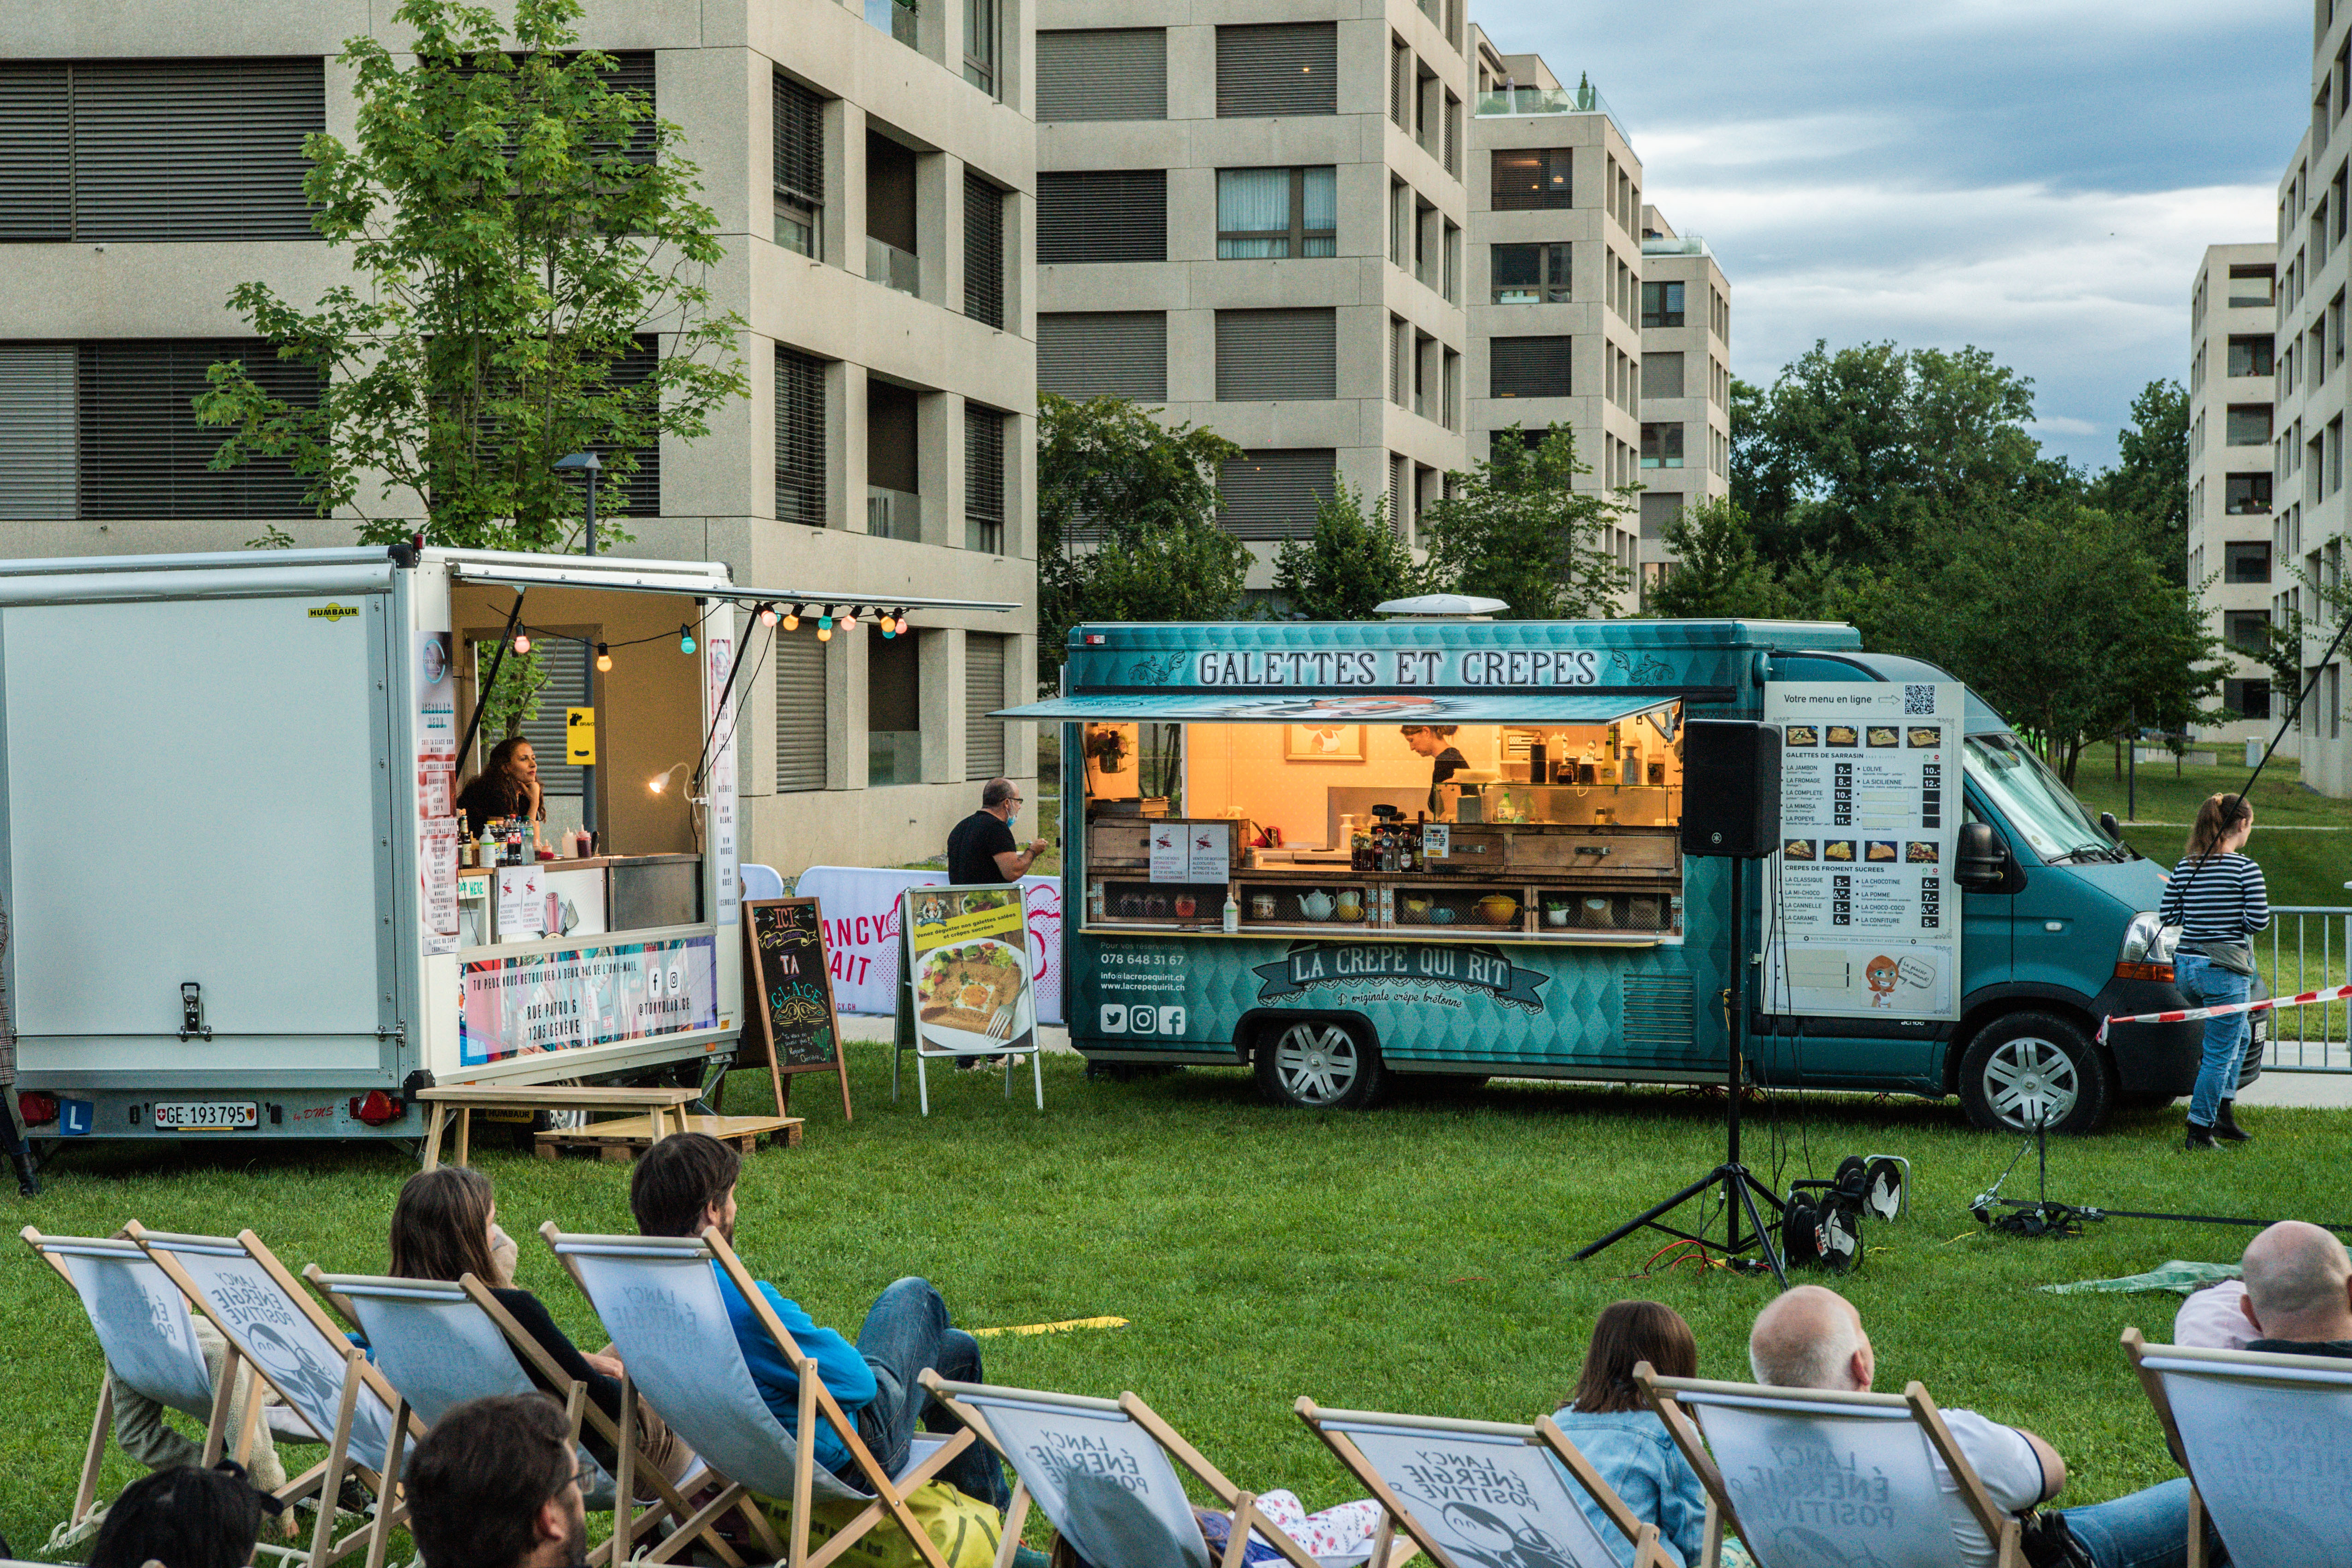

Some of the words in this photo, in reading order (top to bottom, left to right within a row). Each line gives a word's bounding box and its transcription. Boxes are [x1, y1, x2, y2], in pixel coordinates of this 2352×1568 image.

[1200, 652, 1376, 685] GALETTES
[1397, 652, 1443, 685] ET
[1462, 652, 1595, 685] CREPES
[1784, 694, 1806, 703] Votre
[1851, 695, 1872, 705] ligne
[470, 881, 483, 896] HERE
[773, 907, 796, 929] ICI
[935, 925, 959, 935] déguster
[973, 917, 996, 927] galettes
[998, 912, 1016, 920] salées
[951, 929, 970, 938] crêpes
[971, 924, 994, 933] sucrées
[780, 955, 800, 975] TA
[828, 948, 871, 985] AIT
[1101, 953, 1123, 964] 078
[1127, 954, 1150, 964] 648
[1154, 955, 1165, 965] 31
[1169, 955, 1184, 965] 67
[1295, 953, 1325, 981] LA
[1336, 945, 1408, 974] CREPE
[1420, 946, 1455, 977] QUI
[1468, 953, 1507, 986] RIT
[474, 980, 481, 991] TU
[485, 978, 500, 989] PEUX
[503, 975, 517, 987] NOUS
[521, 971, 554, 985] RETROUVER
[564, 968, 579, 979] DEUX
[582, 965, 591, 976] PAS
[594, 965, 600, 975] DE
[603, 961, 636, 974] L'UNI-MAIL
[1101, 972, 1185, 981] info@lacrepequirit.ch
[1901, 967, 1929, 982] gourmand!
[1911, 964, 1927, 975] plaisir
[1101, 982, 1185, 991] www.lacrepequirit.ch
[639, 998, 689, 1016] @TOKYOLAB.GE
[1352, 989, 1390, 1006] originale
[1394, 991, 1419, 1006] crêpe
[1423, 989, 1462, 1008] bretonne
[528, 1004, 541, 1020] RUE
[546, 1000, 567, 1016] PATRU
[572, 999, 576, 1013] 6
[529, 1024, 546, 1040] 1205
[550, 1019, 580, 1038] GENÈVE
[70, 1106, 82, 1130] L
[304, 1106, 334, 1119] DMS
